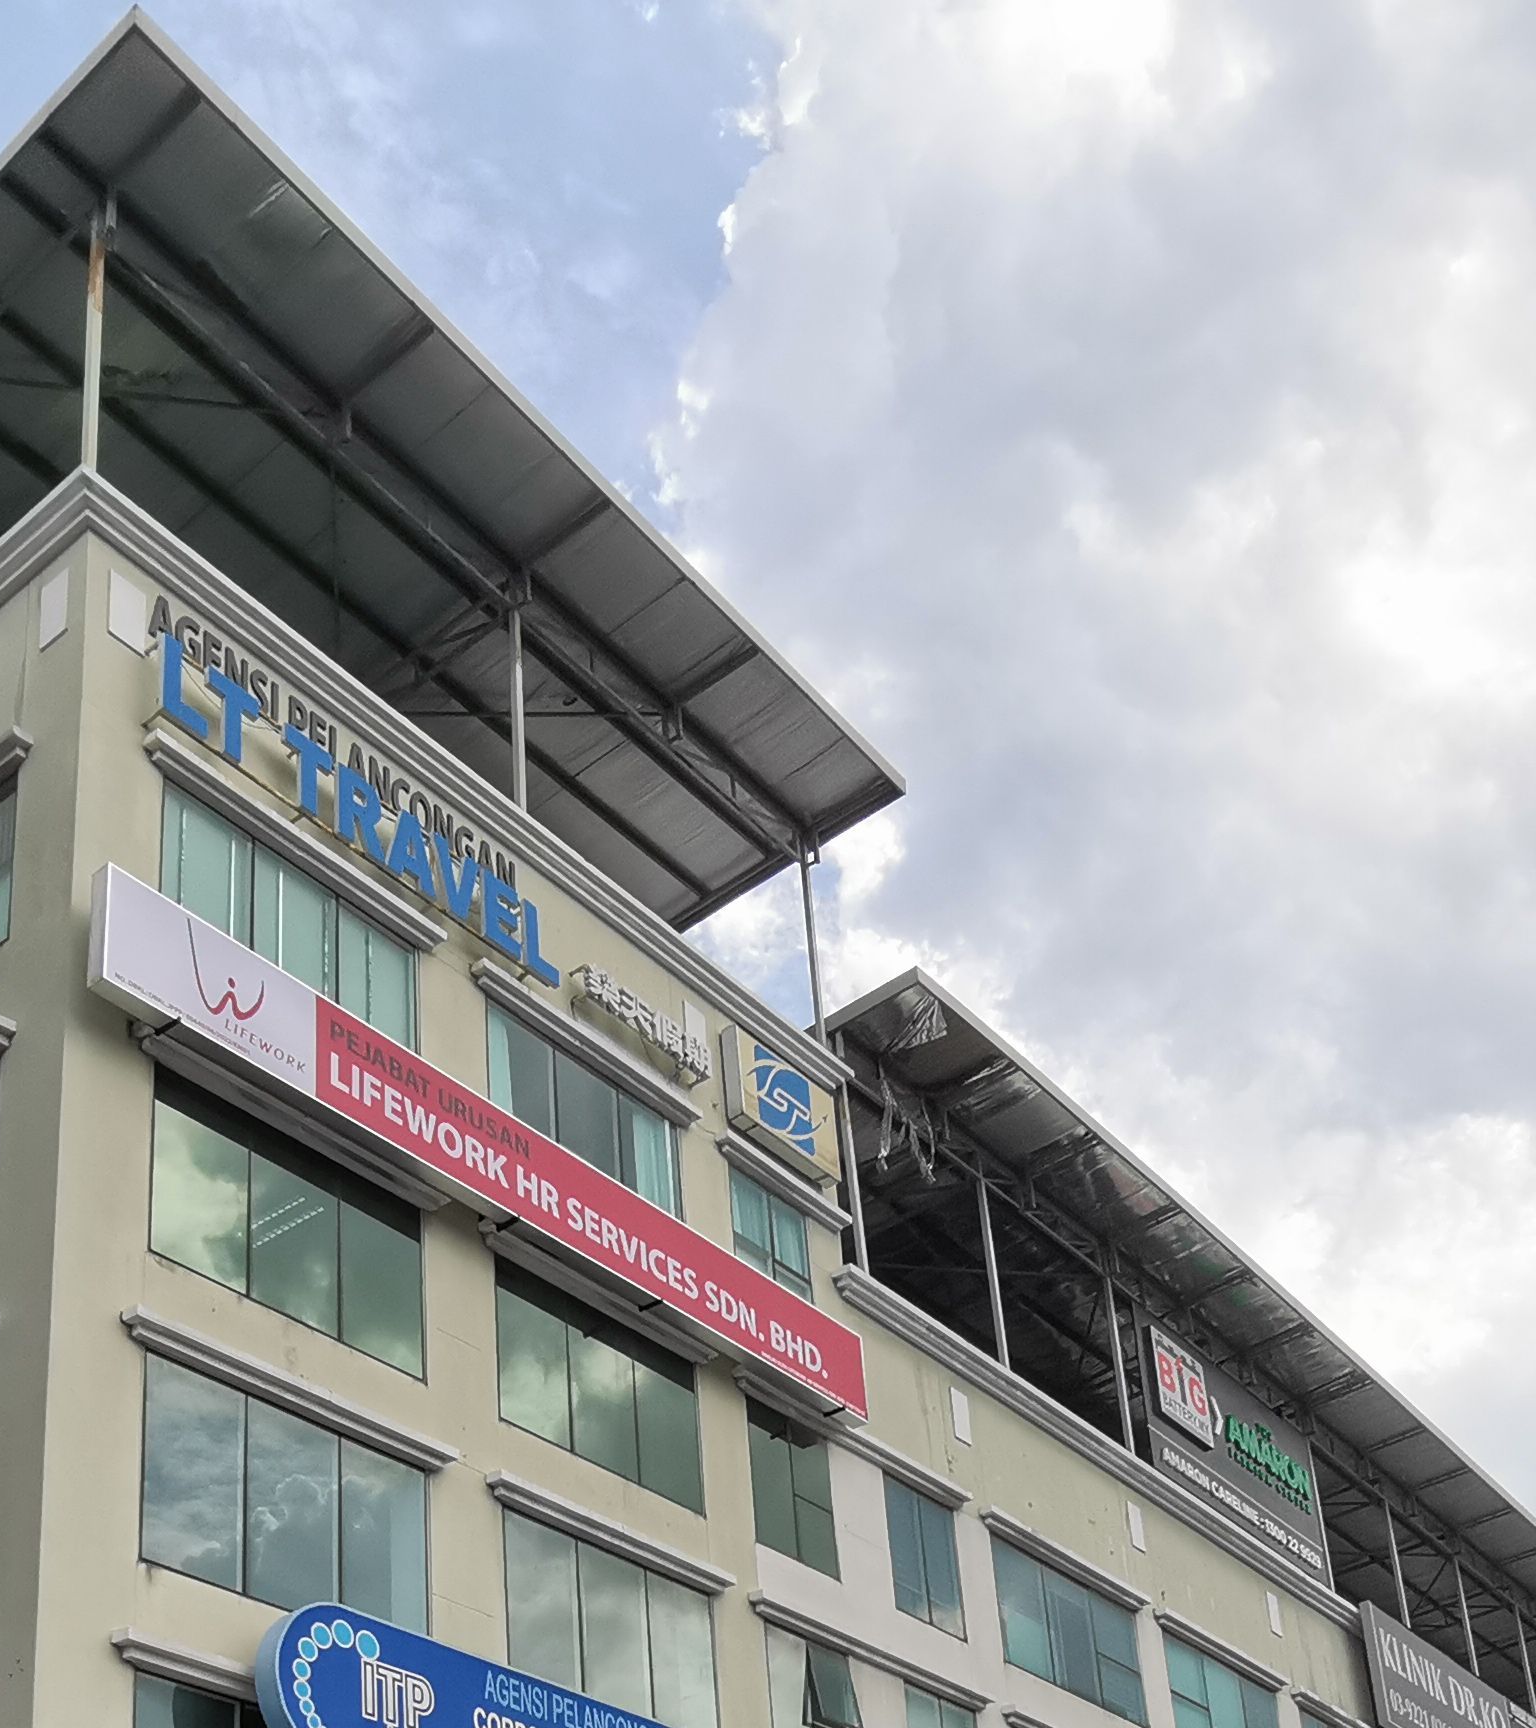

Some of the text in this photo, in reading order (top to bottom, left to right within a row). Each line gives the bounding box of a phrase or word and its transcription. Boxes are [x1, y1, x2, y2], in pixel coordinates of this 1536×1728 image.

[148, 594, 280, 724] AGENSI
[158, 631, 561, 990] LT TRAVEL
[224, 1018, 307, 1074] LIFEWORK
[329, 1017, 531, 1160] PEJABAT URUSAN
[329, 1051, 829, 1379] LIFEWORK HR SERVICES SDN. BHD.
[1162, 1446, 1211, 1492] AMARON
[1224, 1414, 1313, 1500] AMARON
[484, 1669, 548, 1722] AGENSI
[1378, 1627, 1448, 1706] KLINIK
